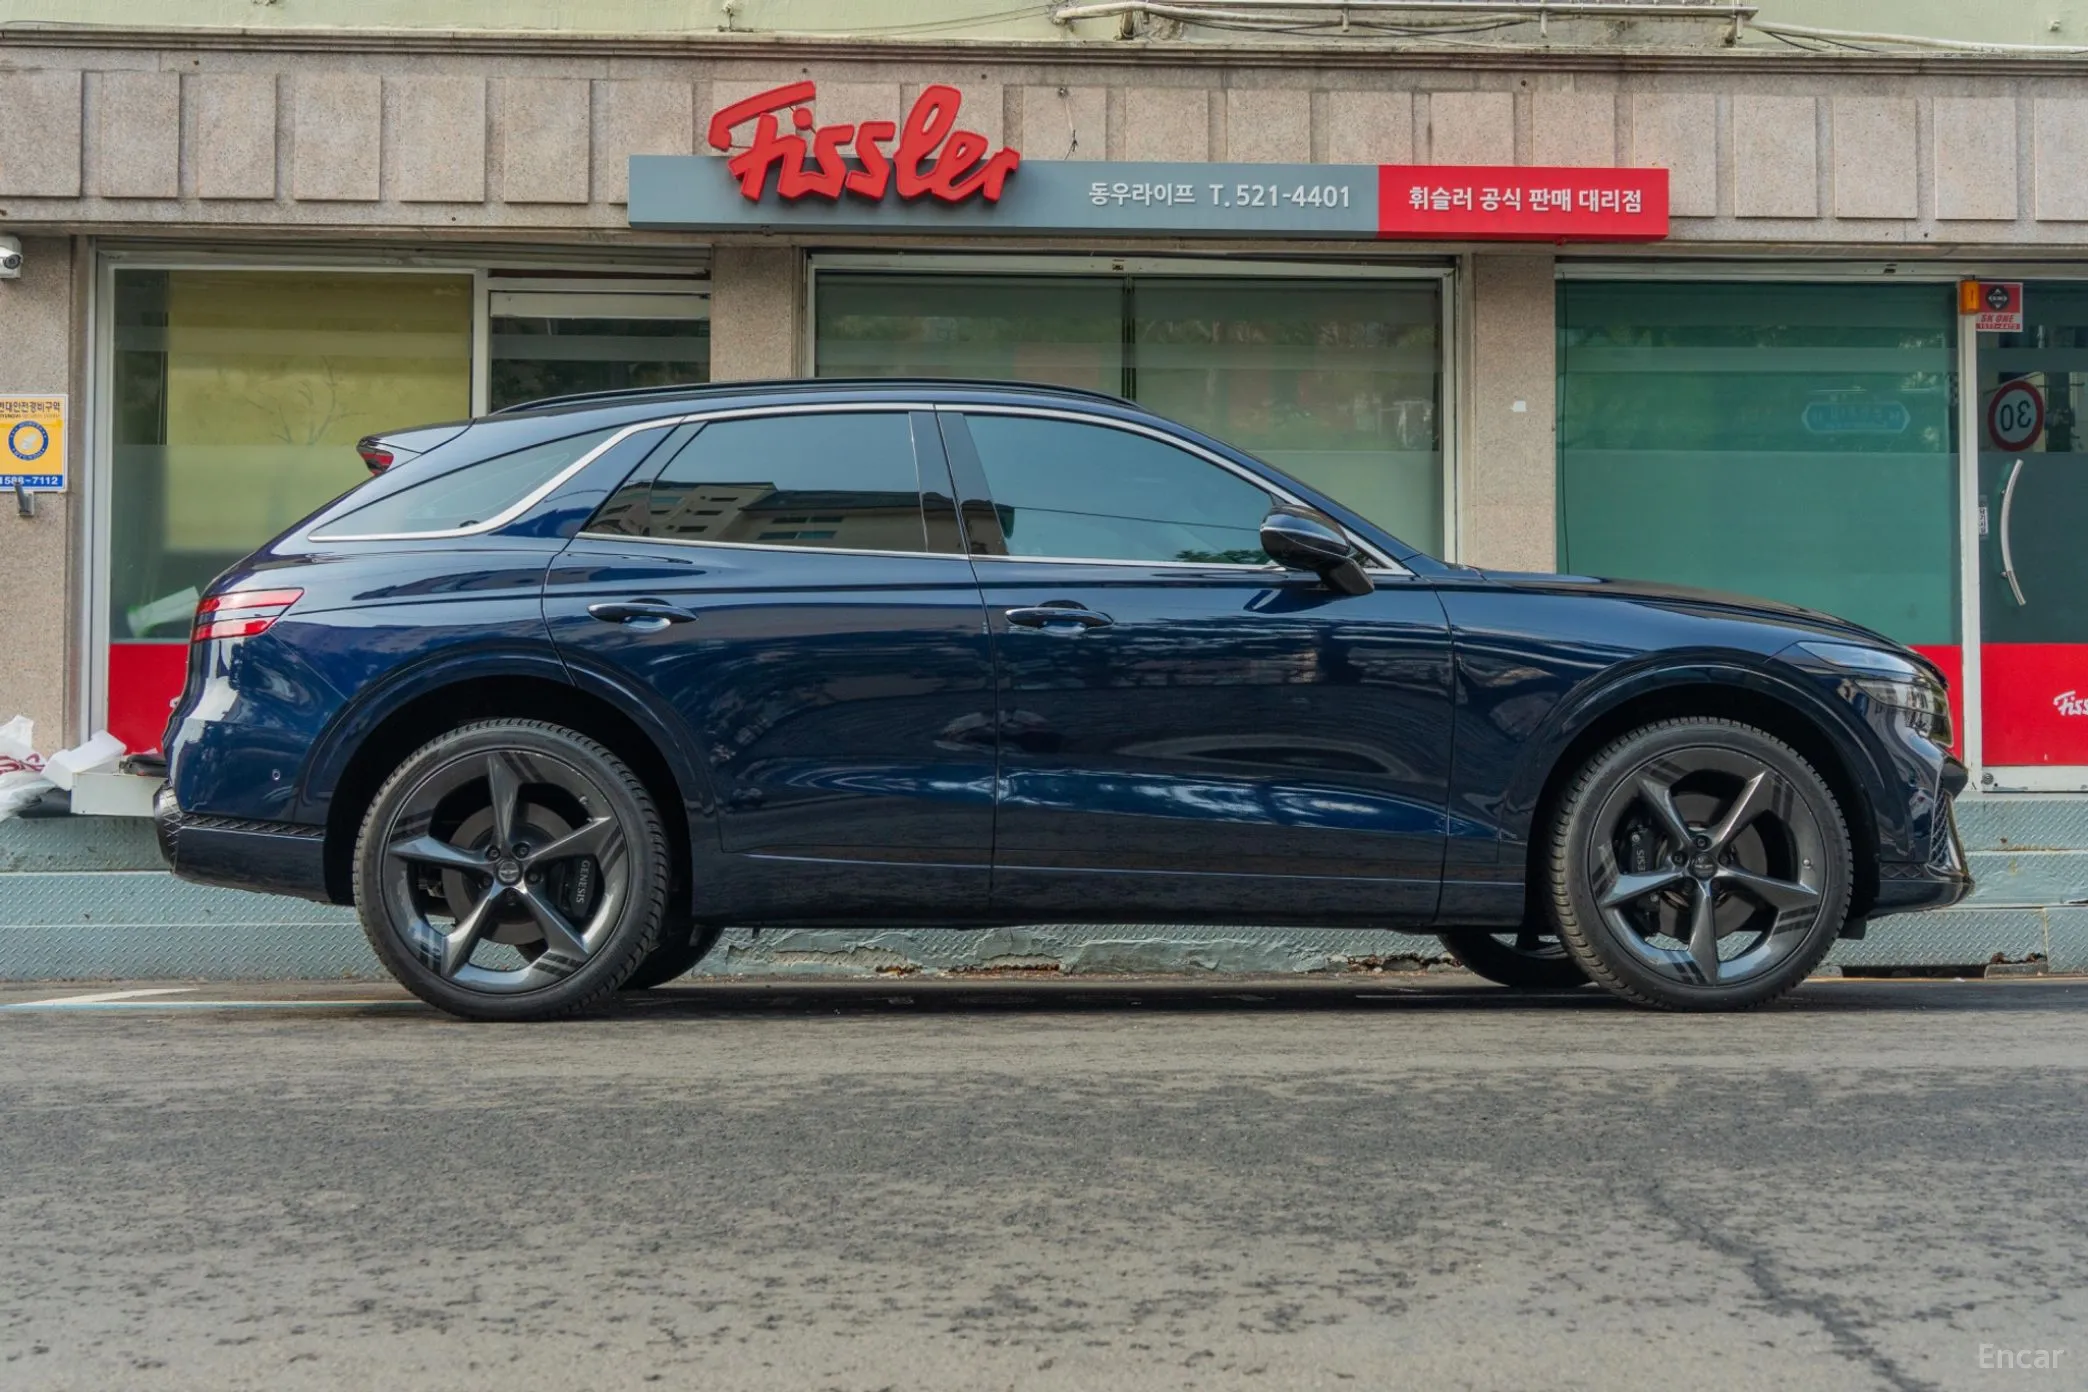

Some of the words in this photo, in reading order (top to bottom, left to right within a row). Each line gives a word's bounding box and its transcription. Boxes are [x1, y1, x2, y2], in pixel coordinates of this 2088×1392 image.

[707, 80, 1021, 203] Fissler
[1089, 182, 1196, 207] 동우라이프
[1209, 184, 1231, 208] T.
[1236, 184, 1350, 208] 521-4401
[1409, 187, 1473, 211] 휘슬러
[1479, 187, 1521, 212] 공식
[1528, 188, 1572, 213] 판매
[1578, 189, 1642, 213] 대리점
[576, 860, 590, 903] GENESIS
